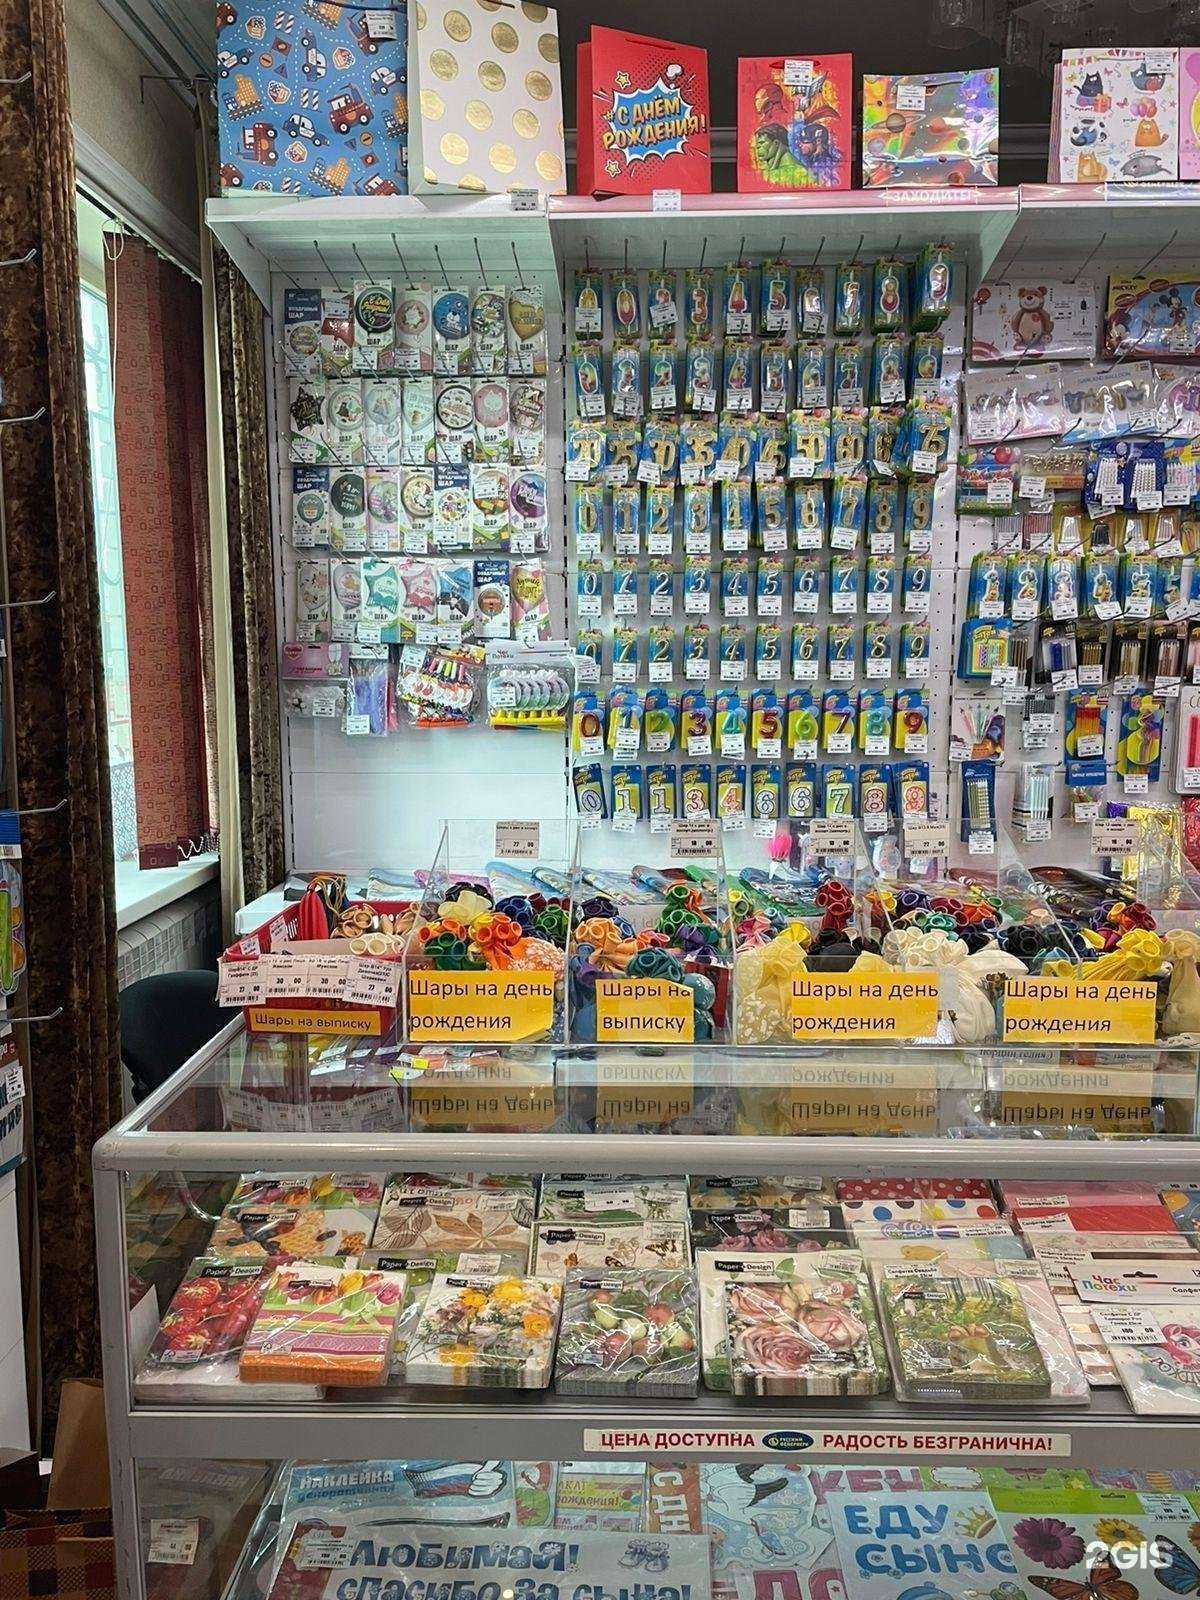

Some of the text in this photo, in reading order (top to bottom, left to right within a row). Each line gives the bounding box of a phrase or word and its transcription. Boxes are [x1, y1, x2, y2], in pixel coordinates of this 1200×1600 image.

[617, 95, 681, 125] С ДНЁМ
[602, 114, 707, 149] РОЖДЕНИЯ!
[651, 504, 669, 534] 2
[765, 498, 781, 529] 5
[875, 501, 891, 532] 8
[912, 498, 930, 529] 9
[584, 572, 597, 595] 0
[654, 572, 668, 596] 2
[690, 570, 705, 592] 3
[727, 572, 742, 595] 4
[764, 570, 779, 595] 5
[800, 569, 814, 593] 6
[874, 569, 889, 593] 8
[912, 568, 926, 591] 9
[654, 638, 669, 662] 2
[726, 638, 740, 661] 4
[763, 636, 777, 659] 5
[800, 636, 815, 659] 6
[835, 637, 850, 659] 7
[871, 634, 887, 658] 8
[910, 635, 925, 658] 9
[580, 712, 600, 738] 0
[688, 711, 707, 736] 3
[721, 710, 740, 735] 4
[760, 710, 777, 739] 5
[796, 711, 813, 739] 6
[831, 711, 850, 734] 7
[866, 711, 883, 736] 8
[904, 711, 923, 734] 9
[581, 789, 601, 813] 0
[617, 788, 635, 814] 1
[652, 788, 670, 814] 1
[685, 788, 705, 814] 3
[721, 787, 741, 813] 4
[756, 789, 775, 814] 6
[792, 787, 811, 812] 6
[829, 787, 849, 813] 7
[865, 788, 884, 814] 8
[410, 979, 552, 1000] Шары на день
[602, 982, 691, 1000] Шары на
[792, 981, 939, 1001] Шары на день
[1006, 980, 1156, 1003] Шары на день
[255, 1014, 371, 1031] Шары на выписку
[410, 1014, 512, 1034] рождения
[602, 1016, 686, 1033] выписку
[792, 1016, 896, 1036] рождения
[1006, 1017, 1111, 1035] рождения
[746, 1263, 772, 1272] Design
[1092, 1274, 1120, 1284] Час
[1082, 1280, 1137, 1292] Потехи
[601, 1432, 1053, 1451] ЦЕНА ДОСТУПНА РАДОСТЬ БЕЗГРАНИЧНА!
[301, 1470, 394, 1489] НАКЛЕЙКА
[844, 1504, 949, 1539] ЕДУ
